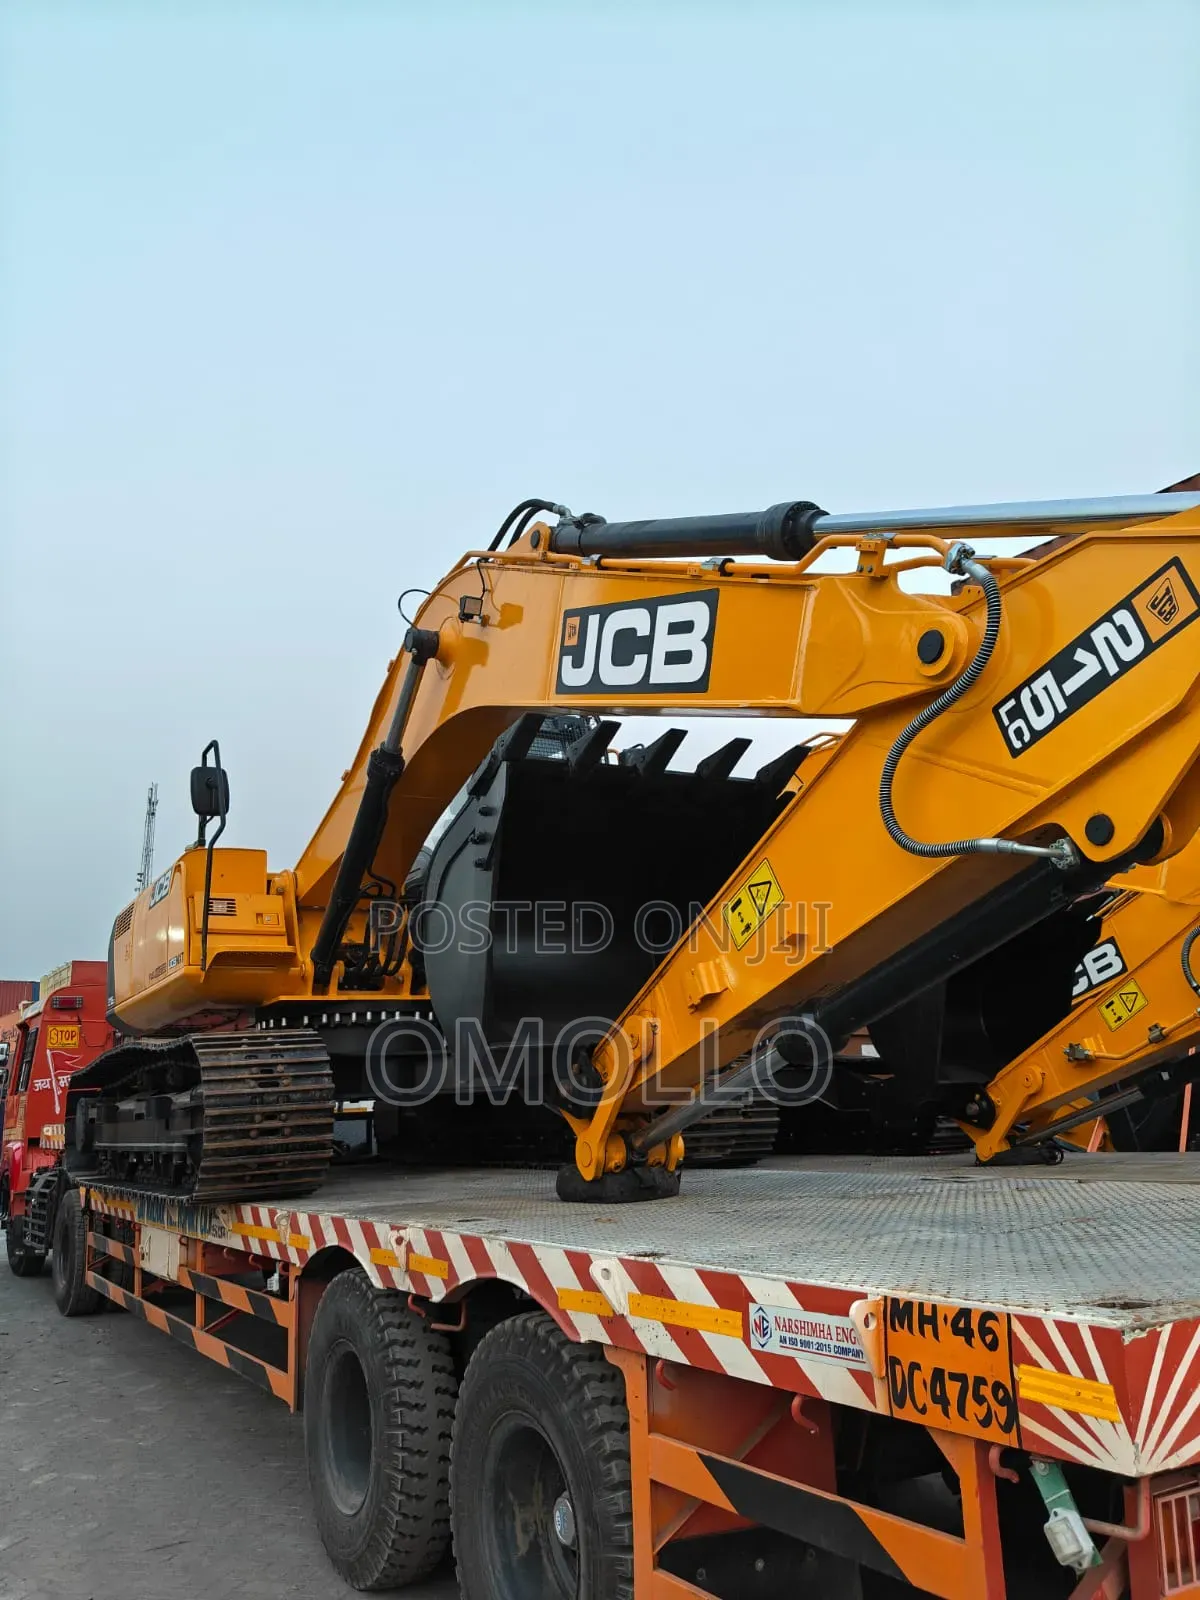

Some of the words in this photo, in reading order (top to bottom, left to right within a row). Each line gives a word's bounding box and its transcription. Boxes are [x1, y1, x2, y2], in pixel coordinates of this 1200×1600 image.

[1151, 586, 1178, 623] JCB
[561, 601, 710, 687] JCB
[774, 1315, 833, 1341] NARSHIMHA
[836, 1326, 861, 1345] ENG
[779, 1335, 788, 1345] AN
[788, 1336, 798, 1347] ISO
[800, 1339, 832, 1353] 9001:2015
[833, 1346, 864, 1360] COMPANY
